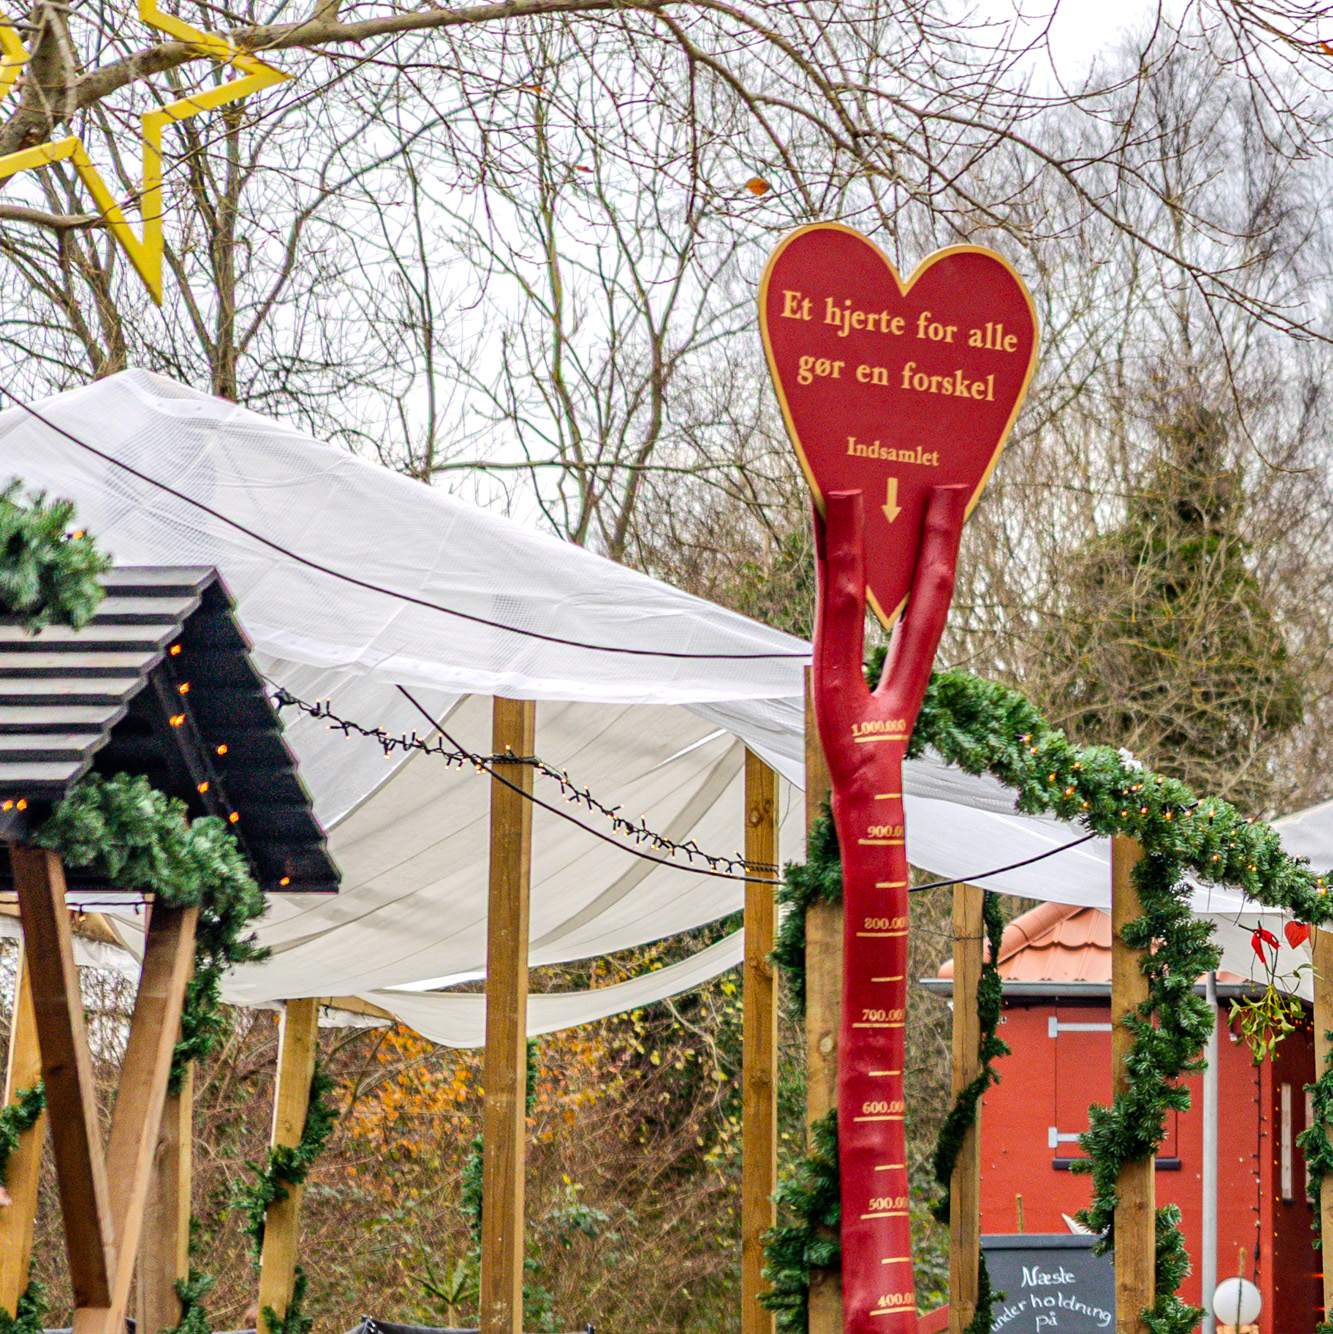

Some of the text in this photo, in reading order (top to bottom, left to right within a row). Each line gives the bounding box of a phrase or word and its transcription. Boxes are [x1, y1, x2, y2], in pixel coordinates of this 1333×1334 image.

[781, 290, 1018, 352] Et hjerte for alle
[797, 355, 995, 401] gør en forskel
[846, 437, 940, 466] Indsamlet
[1021, 1265, 1076, 1288] Næste
[1035, 1311, 1058, 1333] på
